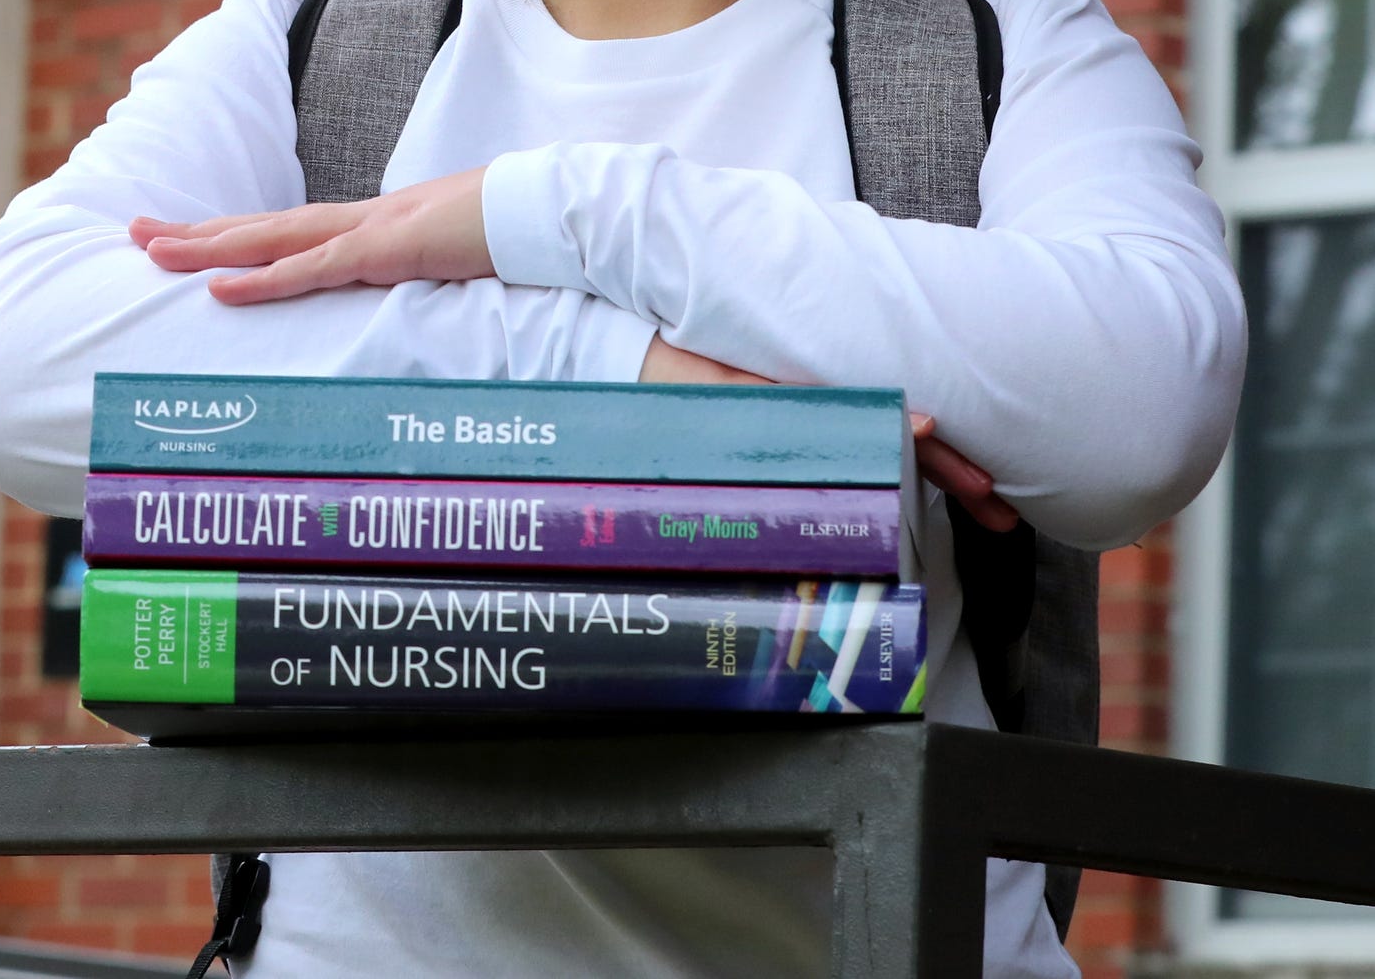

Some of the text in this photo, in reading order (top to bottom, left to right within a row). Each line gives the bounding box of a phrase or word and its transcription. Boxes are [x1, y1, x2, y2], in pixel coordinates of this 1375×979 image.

[134, 399, 242, 419] KAPLAN
[388, 414, 556, 446] The Basics
[159, 441, 216, 453] NURSING
[135, 490, 308, 547] CALCULATE
[317, 502, 338, 537] with
[348, 495, 544, 552] CONFIDENCE
[659, 513, 758, 543] Gray Morris
[800, 522, 870, 538] ELSEVIER
[134, 598, 152, 671] POTTER
[158, 603, 176, 665] PERRY
[198, 601, 212, 669] STOCKERT
[273, 587, 670, 635] FUNDAMENTALS
[216, 620, 227, 652] HALL
[706, 619, 721, 669] NINTH
[723, 611, 736, 677] EDITION
[879, 612, 893, 682] ELSEVIER
[270, 645, 547, 690] OF NURSING
